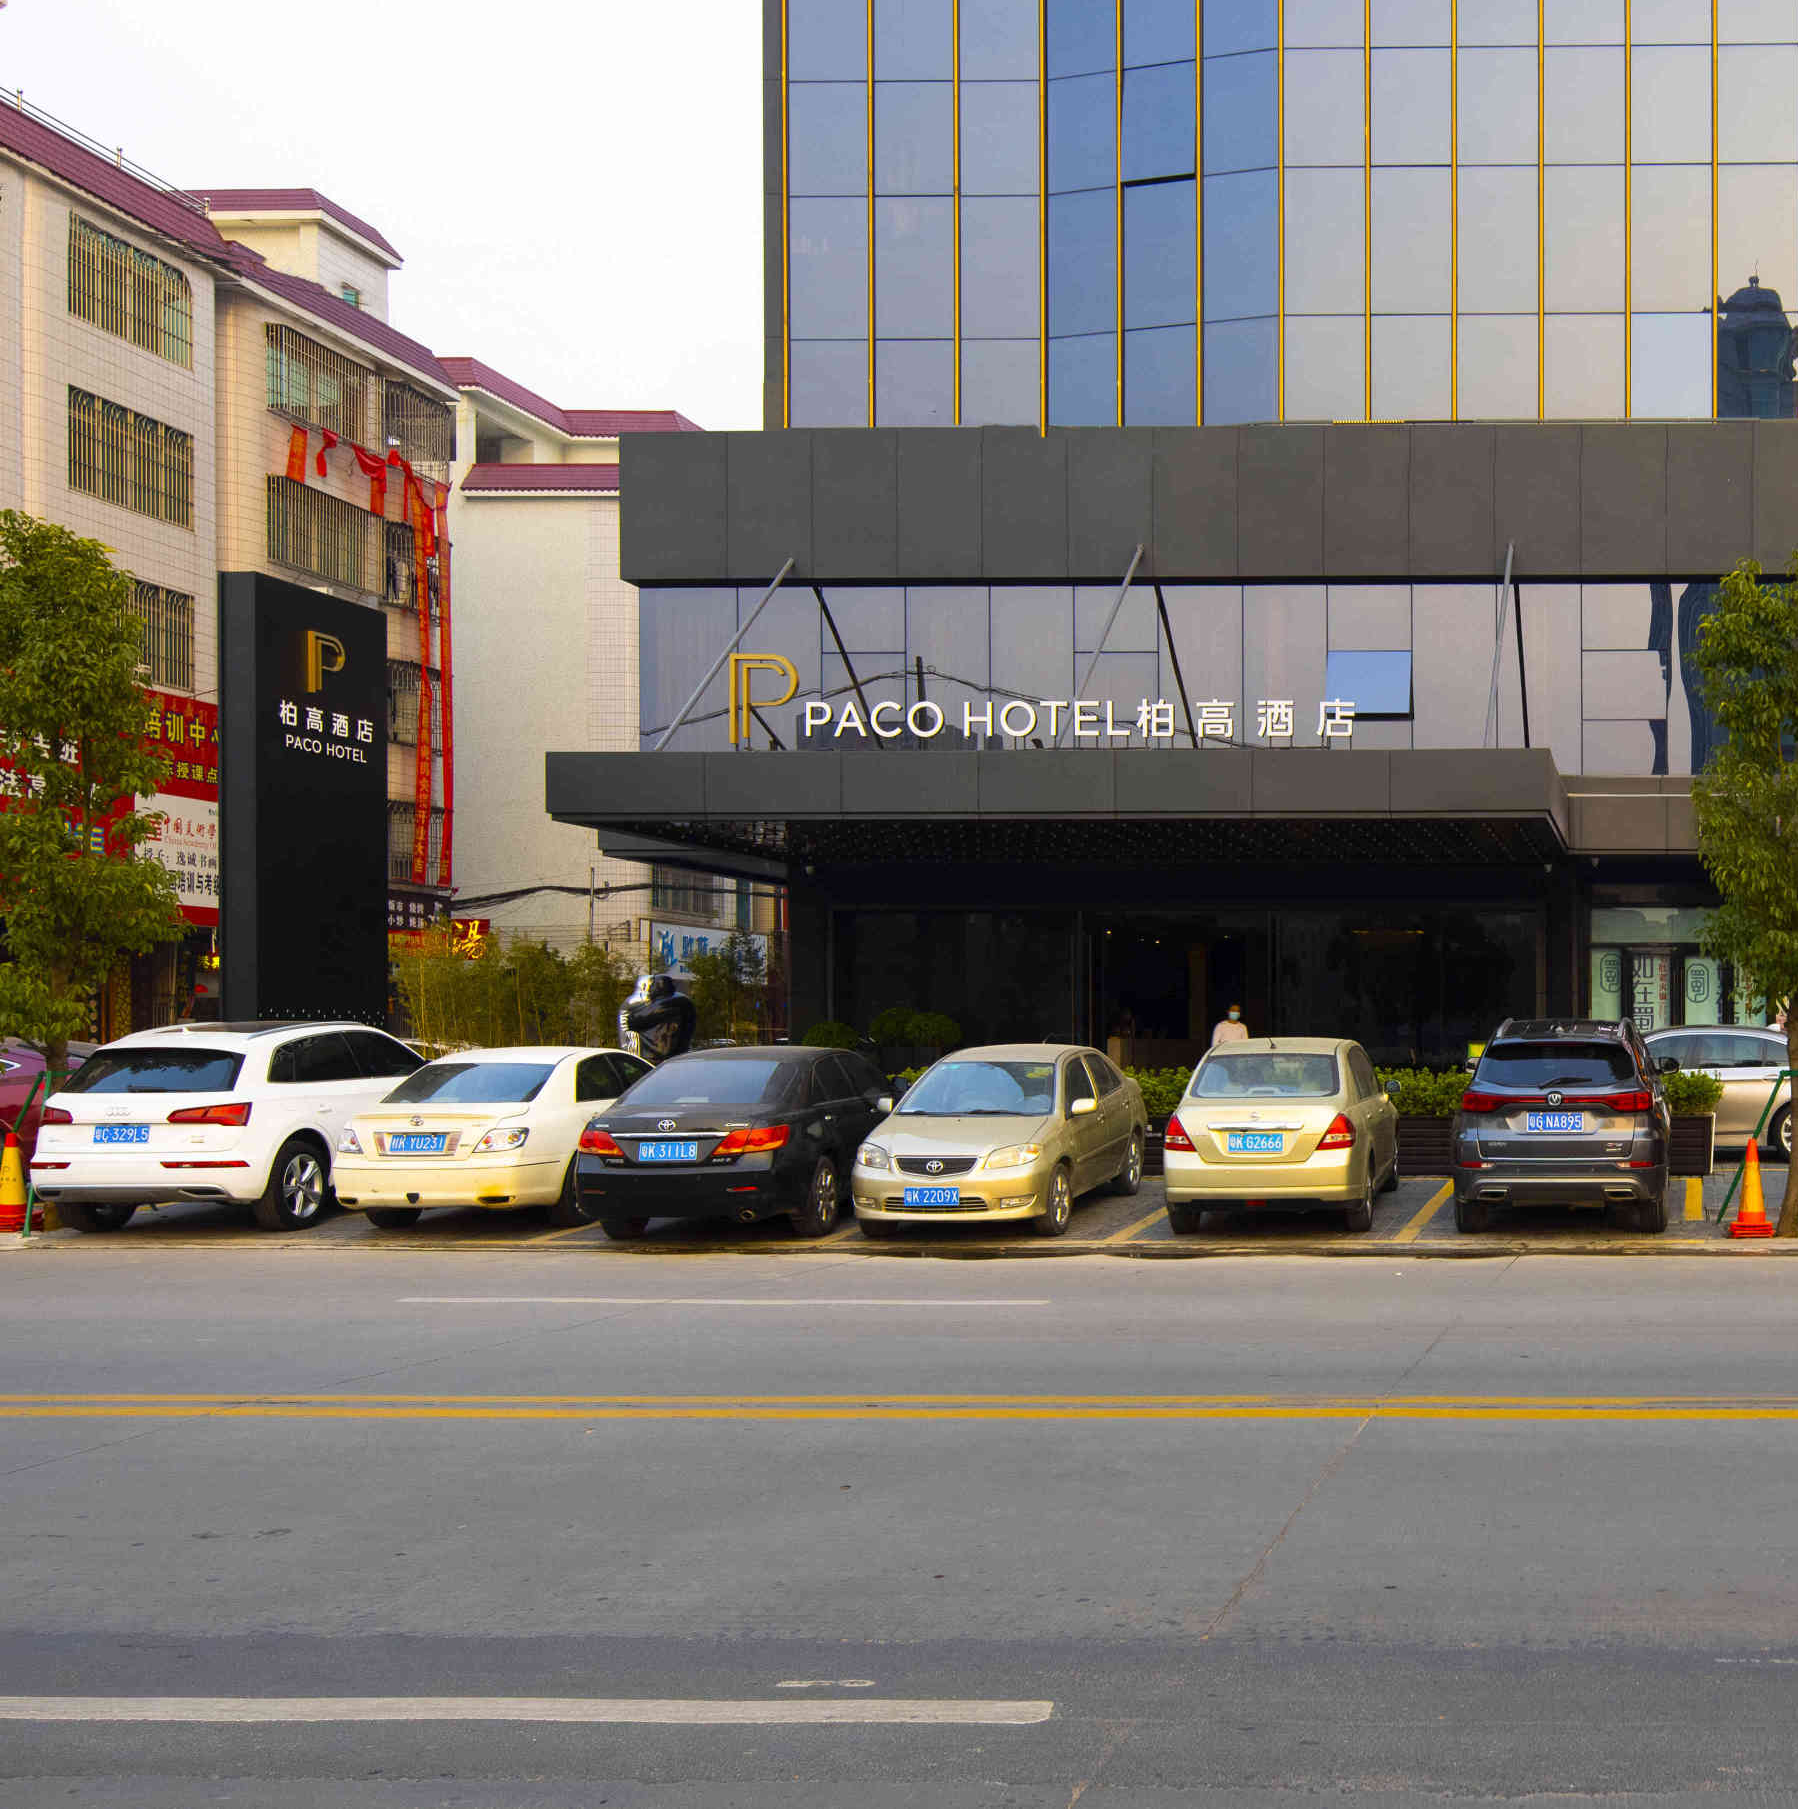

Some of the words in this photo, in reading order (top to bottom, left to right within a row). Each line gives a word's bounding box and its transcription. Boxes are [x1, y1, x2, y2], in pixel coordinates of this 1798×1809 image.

[280, 699, 374, 743] 柏高酒店
[804, 701, 944, 739] PACO
[963, 701, 1136, 738] HOTEL
[1136, 697, 1356, 739] 柏高酒店
[285, 734, 322, 753] PACO
[326, 742, 368, 764] HOTEL
